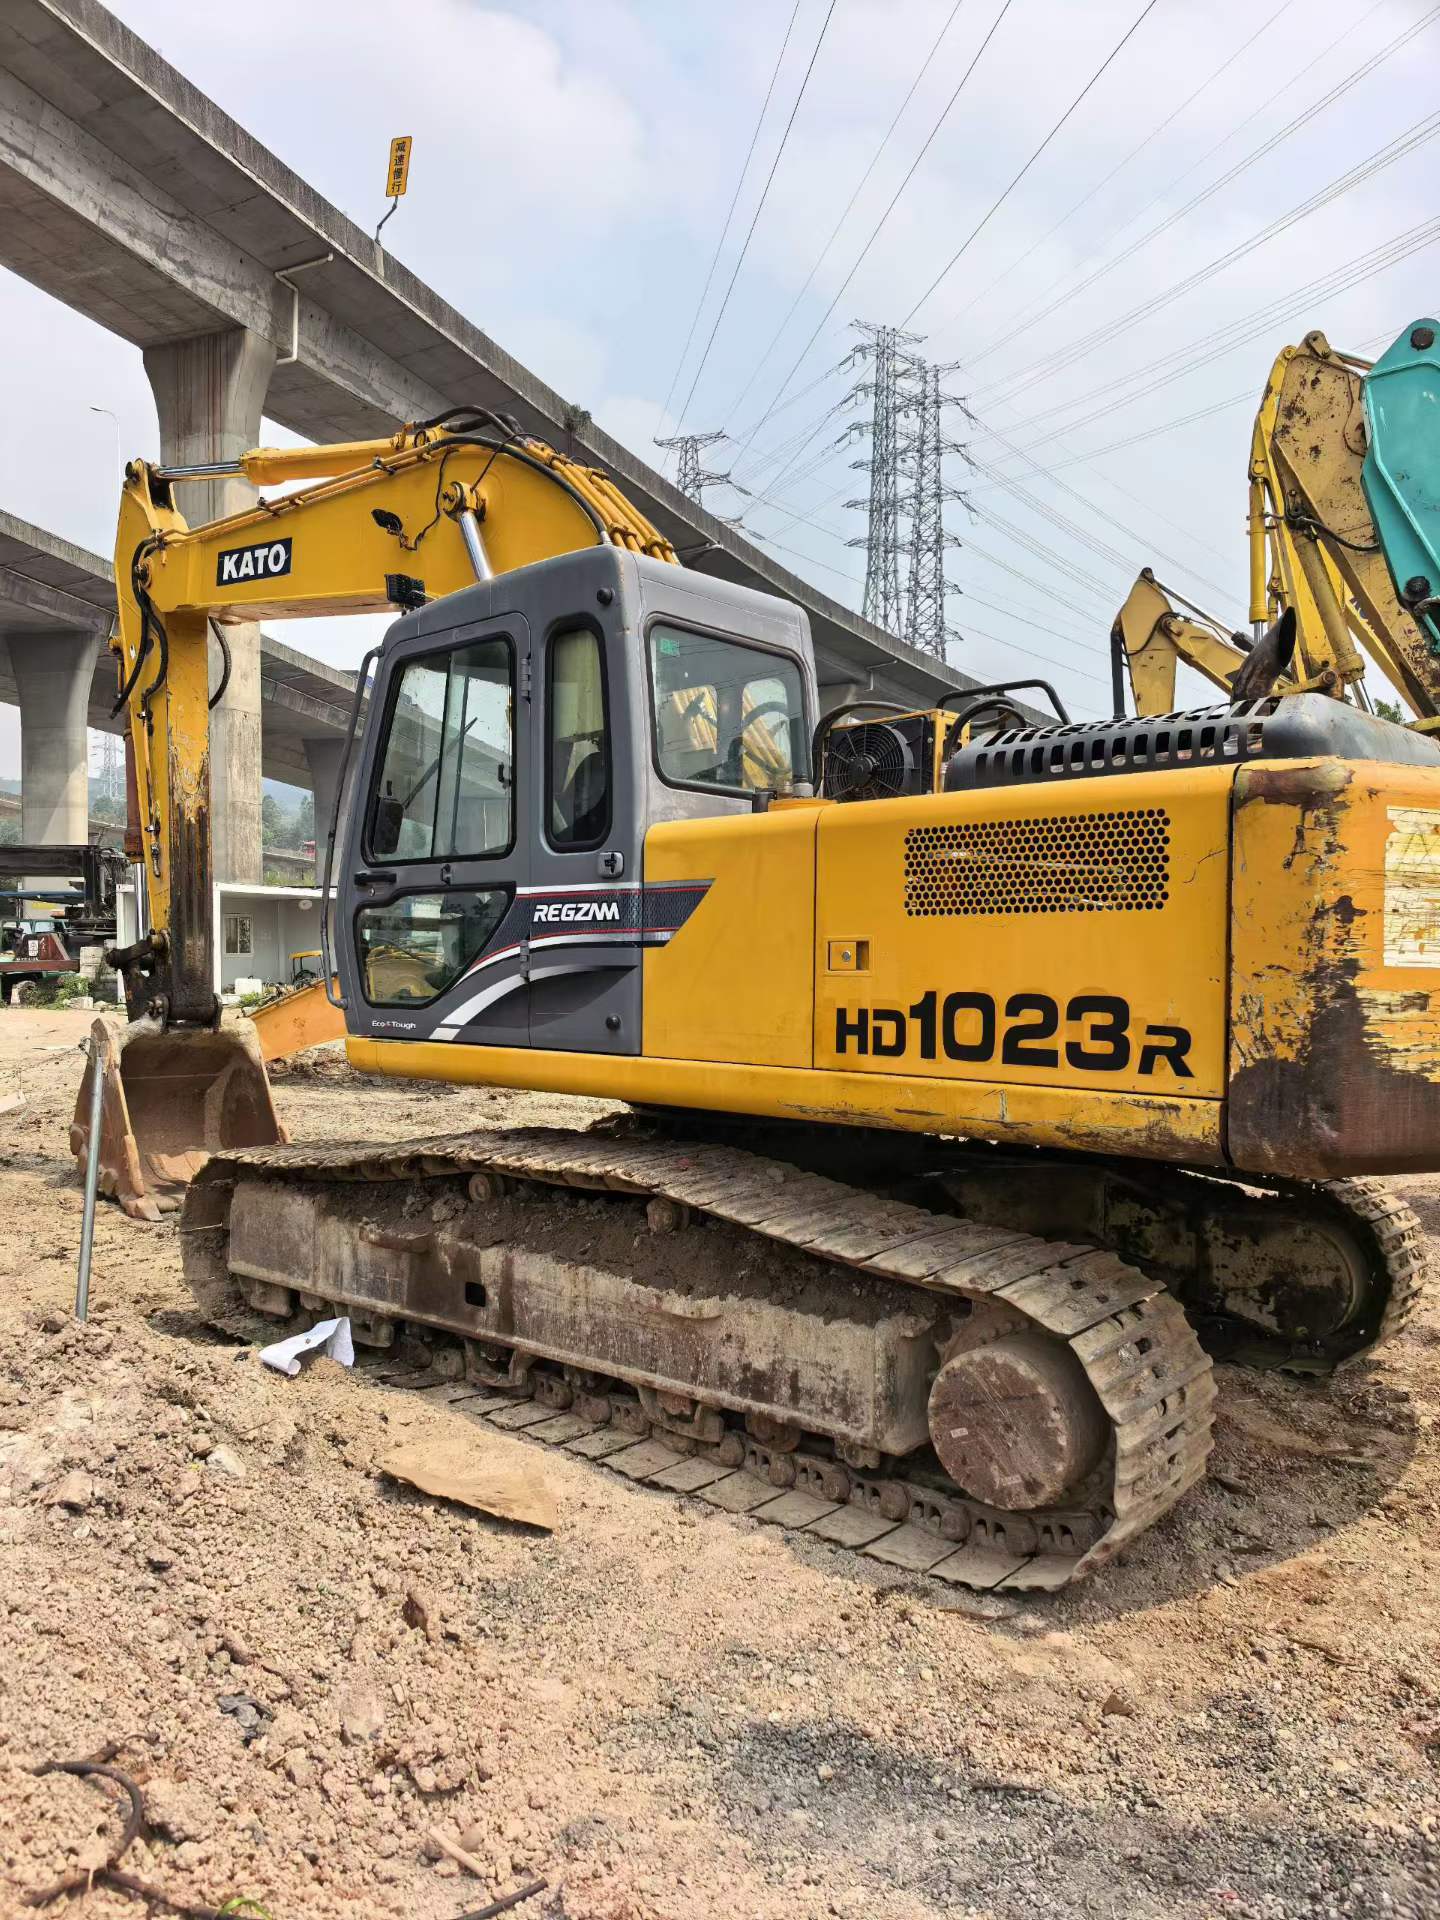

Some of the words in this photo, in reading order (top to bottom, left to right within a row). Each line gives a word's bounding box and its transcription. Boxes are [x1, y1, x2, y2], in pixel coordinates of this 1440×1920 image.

[392, 141, 406, 193] 减速慢行
[222, 543, 286, 581] KATO
[533, 902, 620, 922] REGZAM
[391, 1021, 417, 1030] Tough
[835, 990, 1195, 1078] HD1023R
